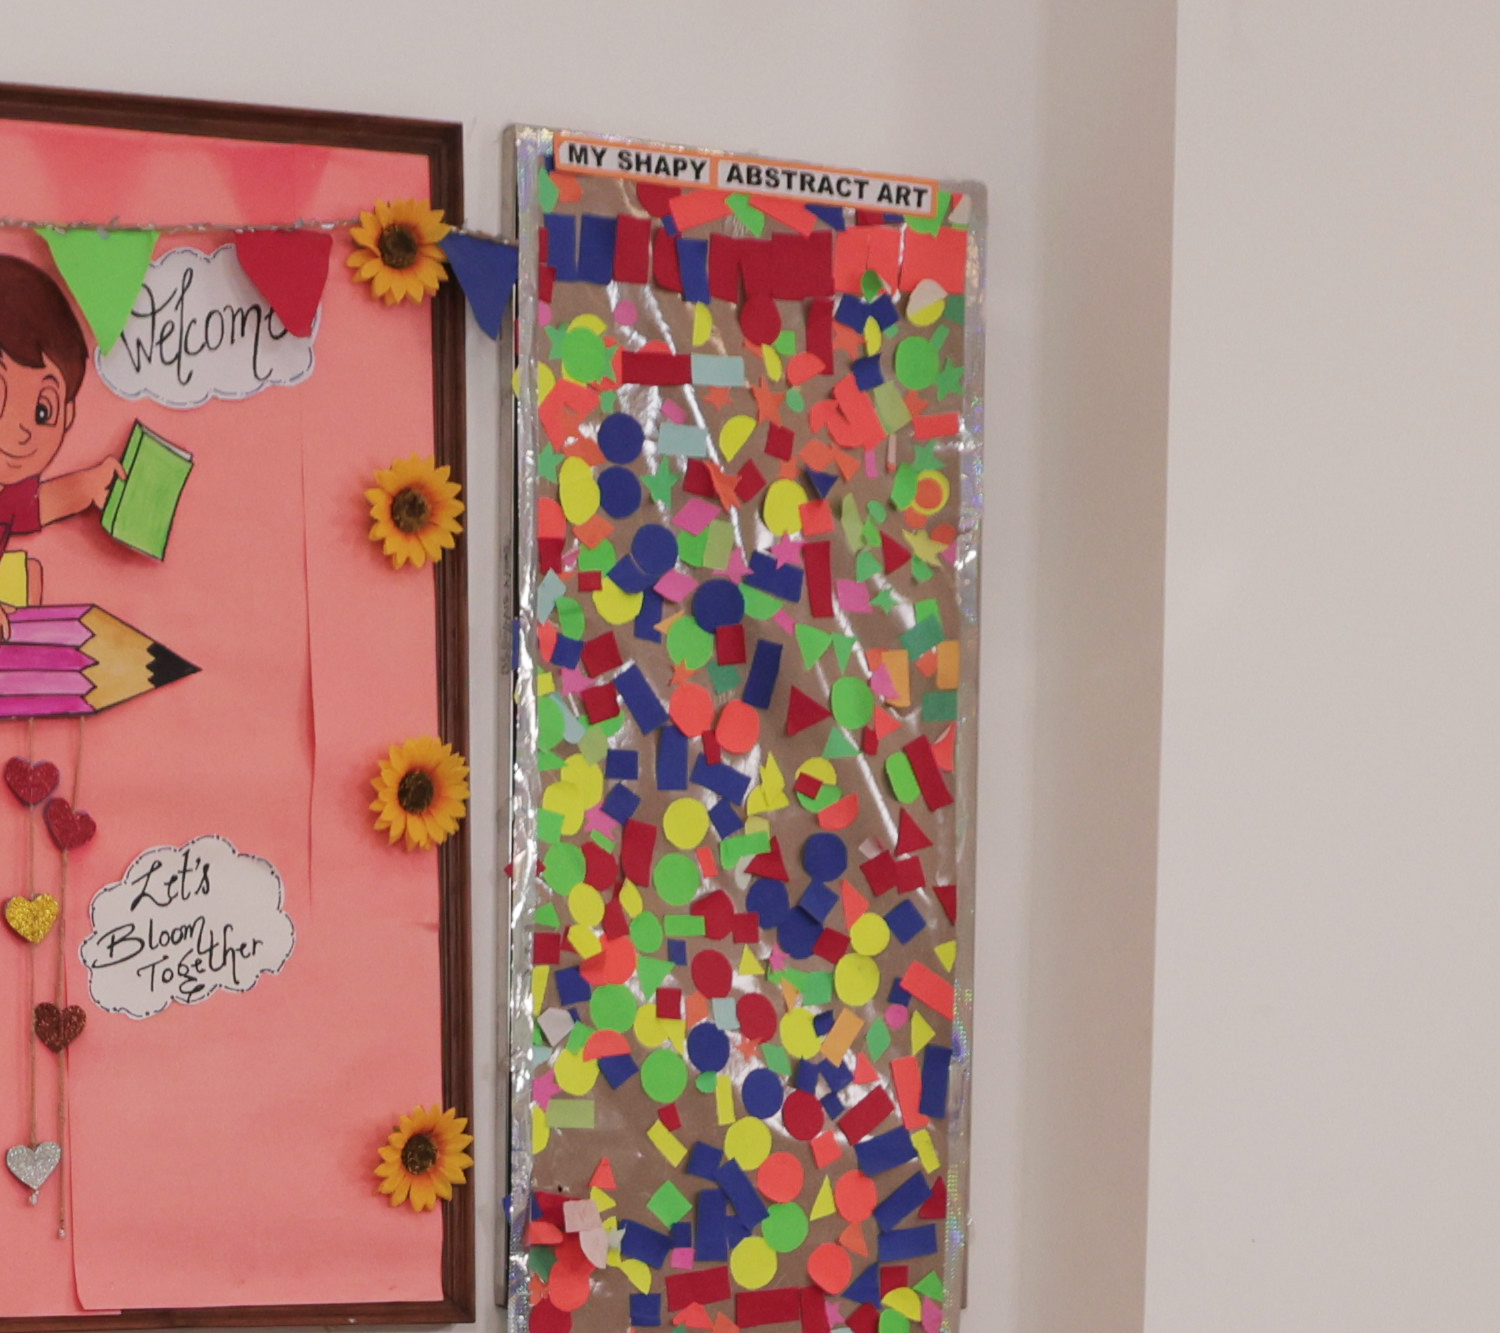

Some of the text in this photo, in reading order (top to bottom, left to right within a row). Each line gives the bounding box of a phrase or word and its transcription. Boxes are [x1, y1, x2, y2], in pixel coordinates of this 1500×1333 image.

[567, 143, 928, 209] MY SHAPY ABSTRACT ART
[129, 849, 211, 911] Let's
[92, 916, 206, 969] Bloom
[137, 924, 263, 1003] Together
